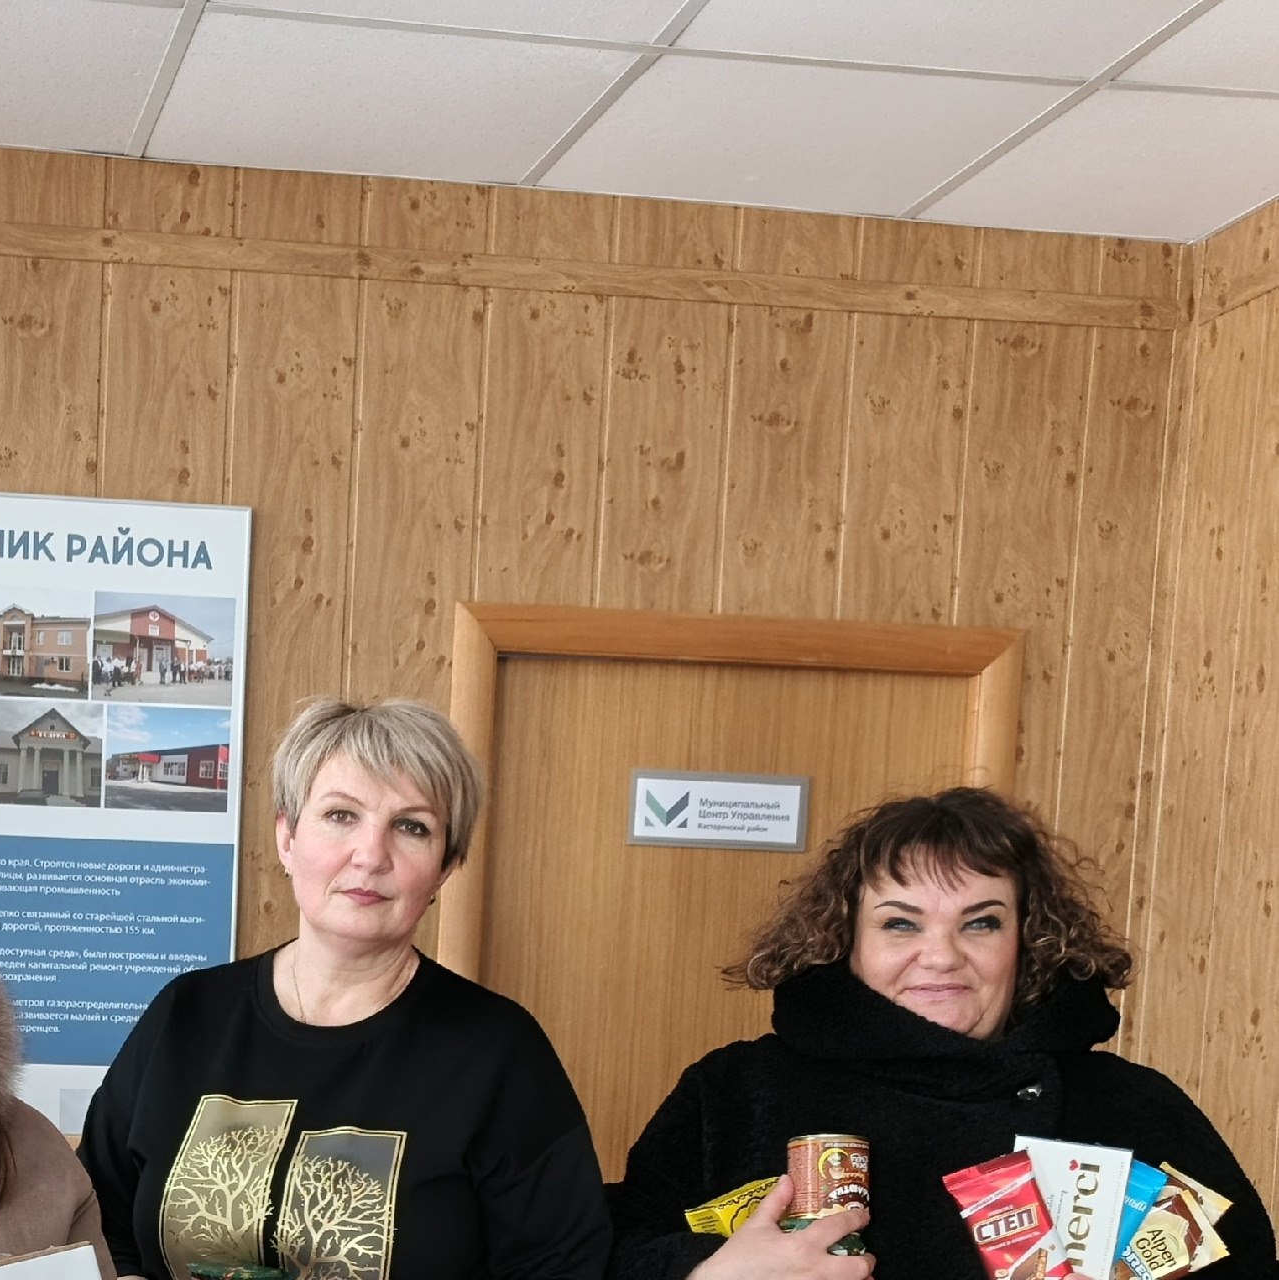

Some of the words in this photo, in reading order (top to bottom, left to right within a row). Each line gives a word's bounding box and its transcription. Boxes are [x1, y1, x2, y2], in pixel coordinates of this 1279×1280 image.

[66, 527, 212, 570] РАЙОНА
[700, 798, 780, 808] Муниципальный
[698, 810, 729, 820] Центр
[731, 811, 790, 821] Управления
[698, 823, 744, 832] Касторенский
[34, 859, 75, 869] Строятся
[78, 862, 106, 870] новые
[108, 863, 141, 873] дороги
[26, 873, 82, 883] развивается
[85, 875, 128, 883] основная
[130, 876, 165, 886] отрасль
[40, 885, 121, 896] промышленность
[22, 910, 70, 920] связанный
[85, 913, 134, 923] старейшей
[137, 914, 178, 923] стальной
[2, 922, 42, 932] дорогой,
[44, 925, 122, 935] протяженностью
[83, 950, 107, 959] были
[109, 952, 158, 961] построены
[169, 954, 207, 962] введены
[28, 961, 87, 971] капитальный
[90, 963, 122, 972] ремонт
[125, 964, 181, 974] учреждений
[70, 1013, 100, 1021] малый
[976, 1209, 1034, 1241] СТЕП
[1136, 1237, 1163, 1271] Gold
[1147, 1229, 1177, 1268] Alpen
